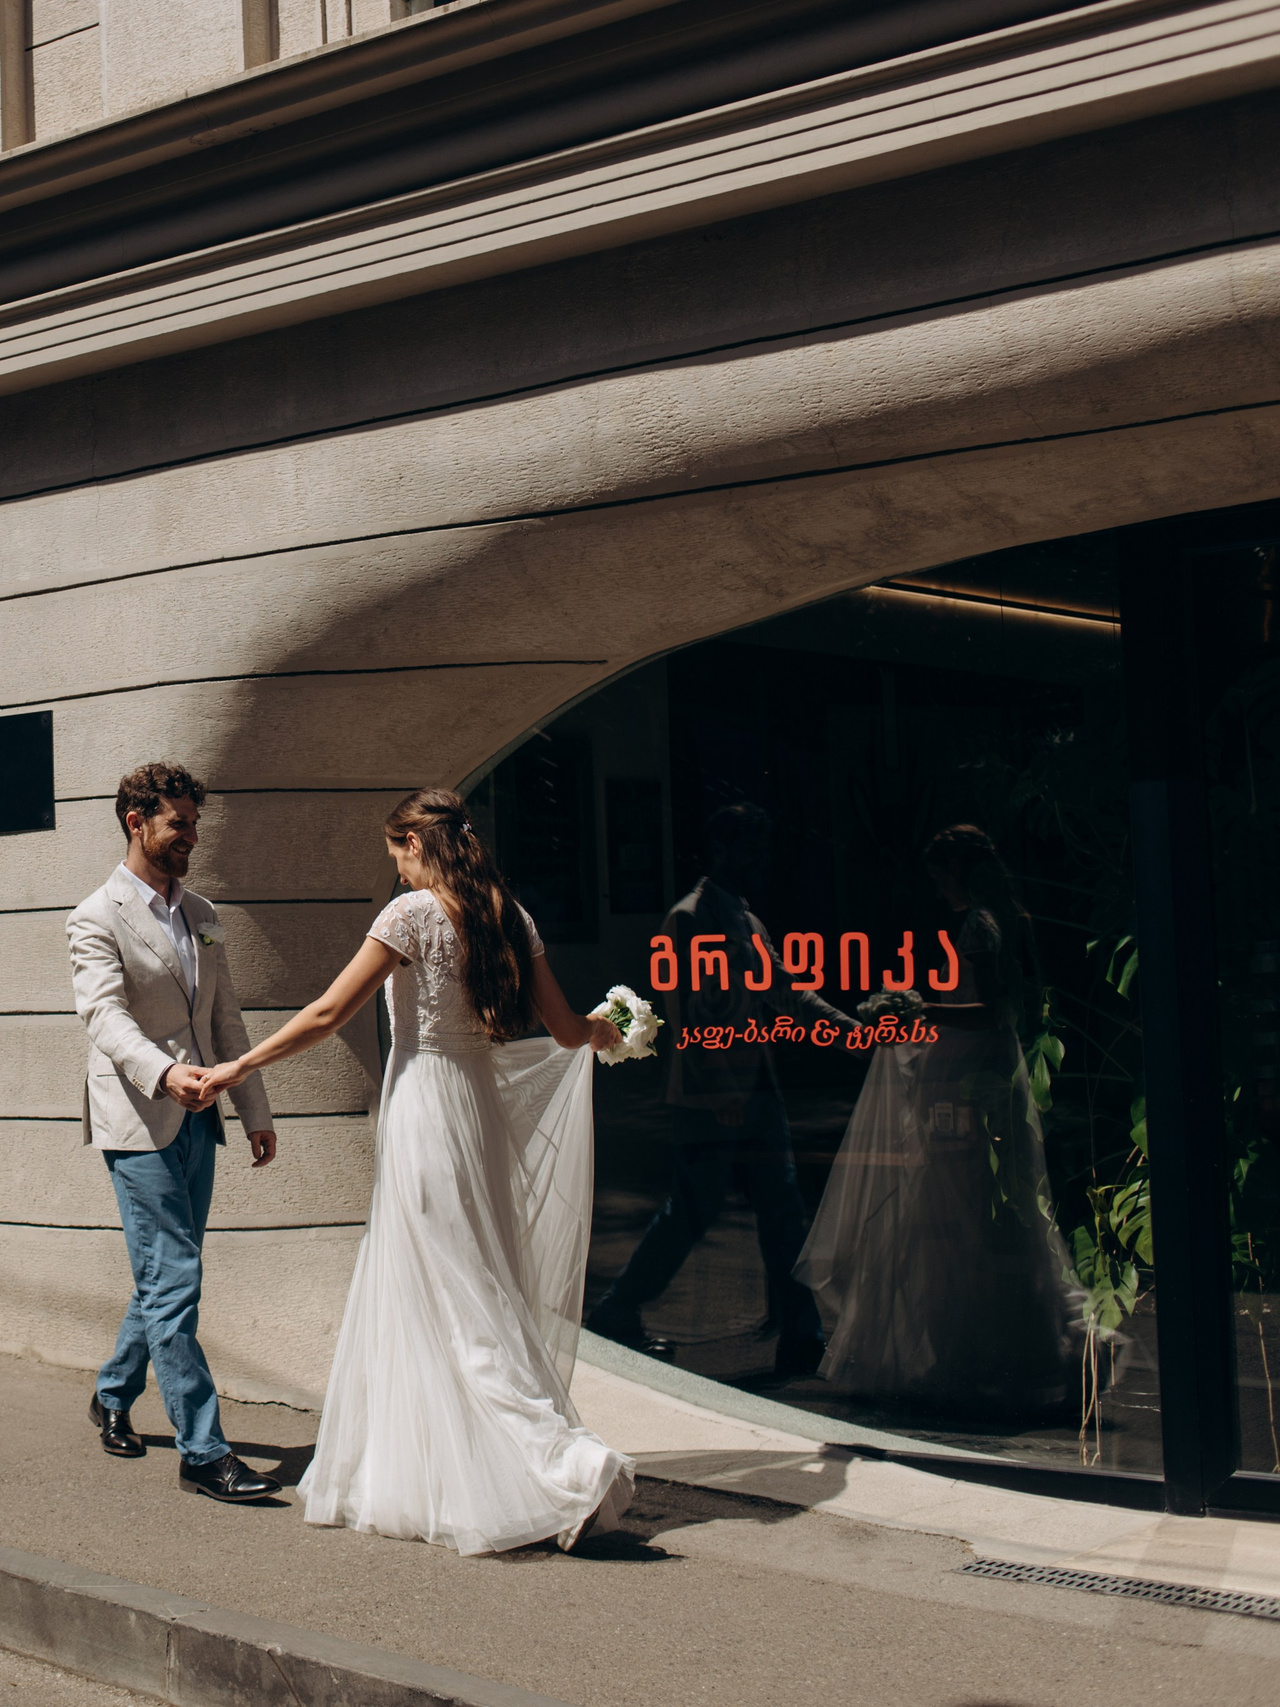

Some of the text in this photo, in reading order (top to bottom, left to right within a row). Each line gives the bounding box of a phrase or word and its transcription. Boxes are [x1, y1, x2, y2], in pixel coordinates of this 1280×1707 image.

[649, 930, 959, 992] გრაფიკა
[676, 1015, 939, 1049] კაფე-ბარი & ტერასა
